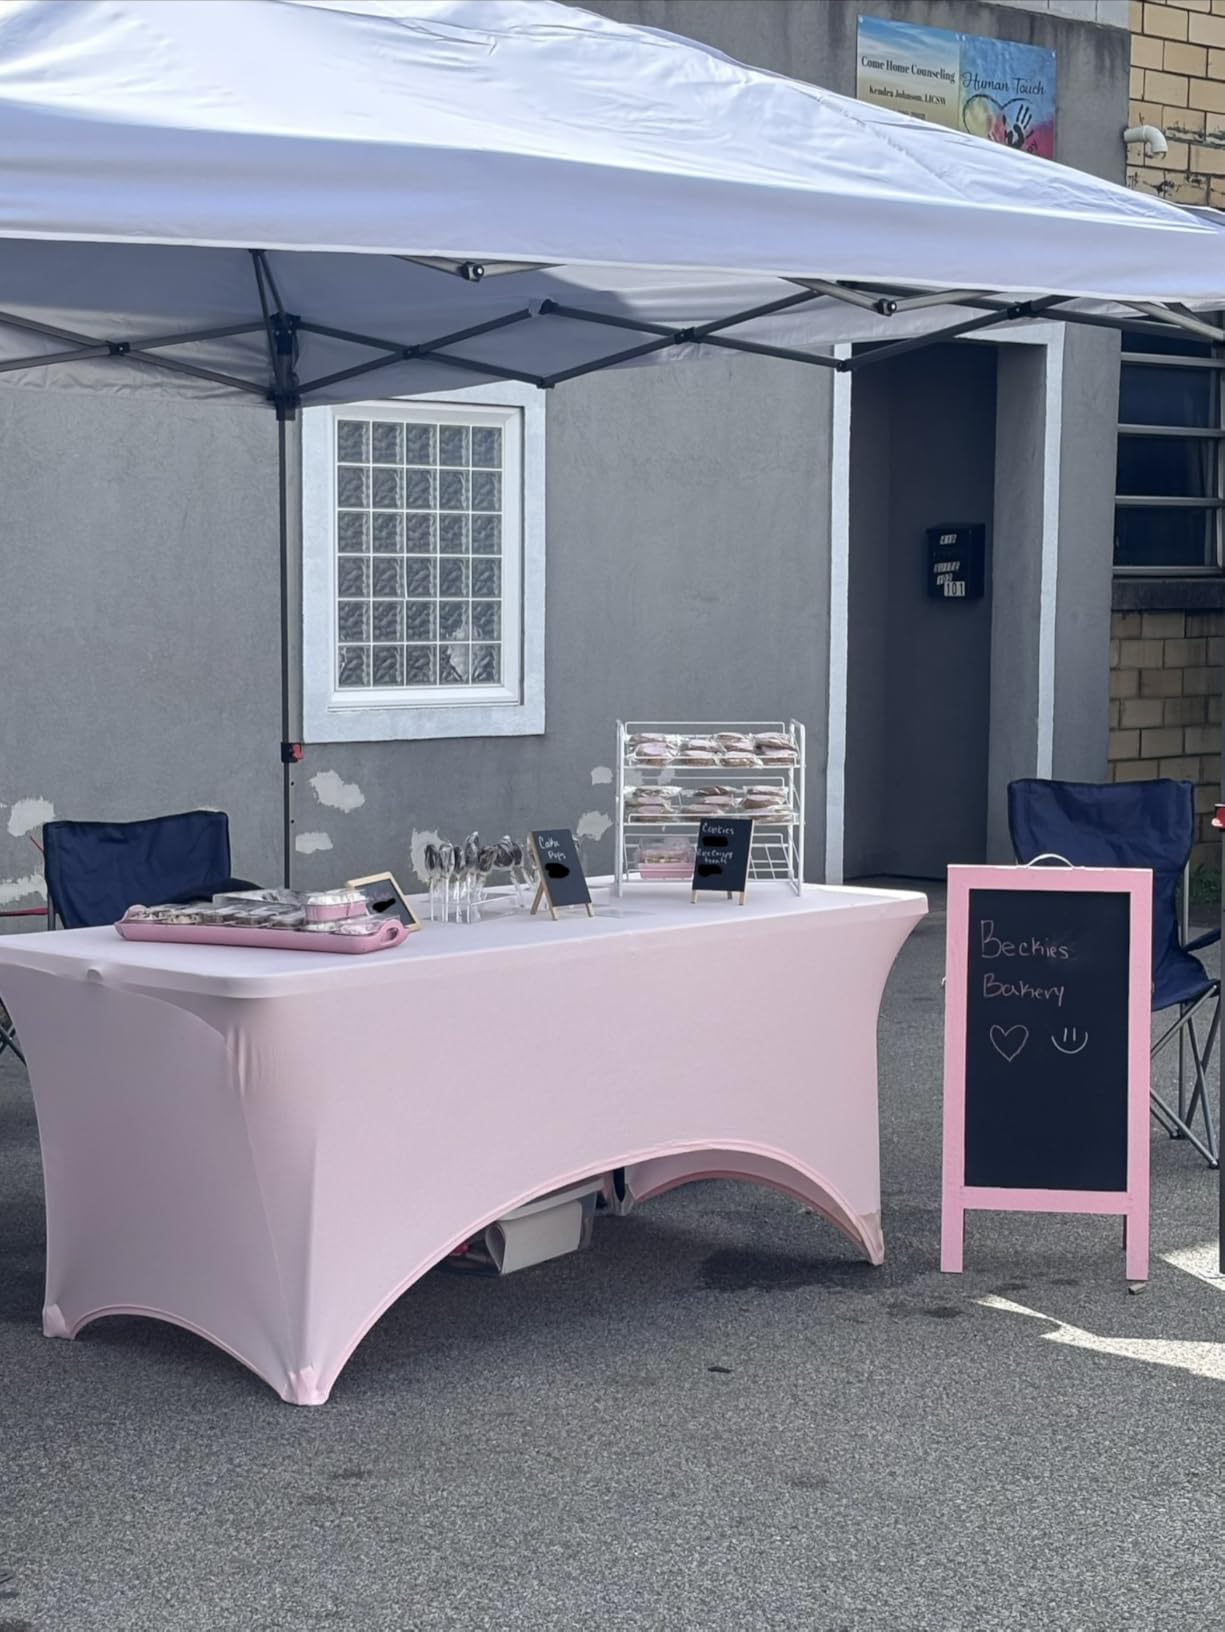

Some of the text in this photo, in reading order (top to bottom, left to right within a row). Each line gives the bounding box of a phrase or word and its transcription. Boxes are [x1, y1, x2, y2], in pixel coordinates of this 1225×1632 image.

[861, 55, 956, 84] Come Home Counseling
[961, 71, 1045, 96] Human Touch
[944, 580, 966, 597] 101
[981, 919, 1070, 959] Beckies
[983, 972, 1065, 1008] Bakery
